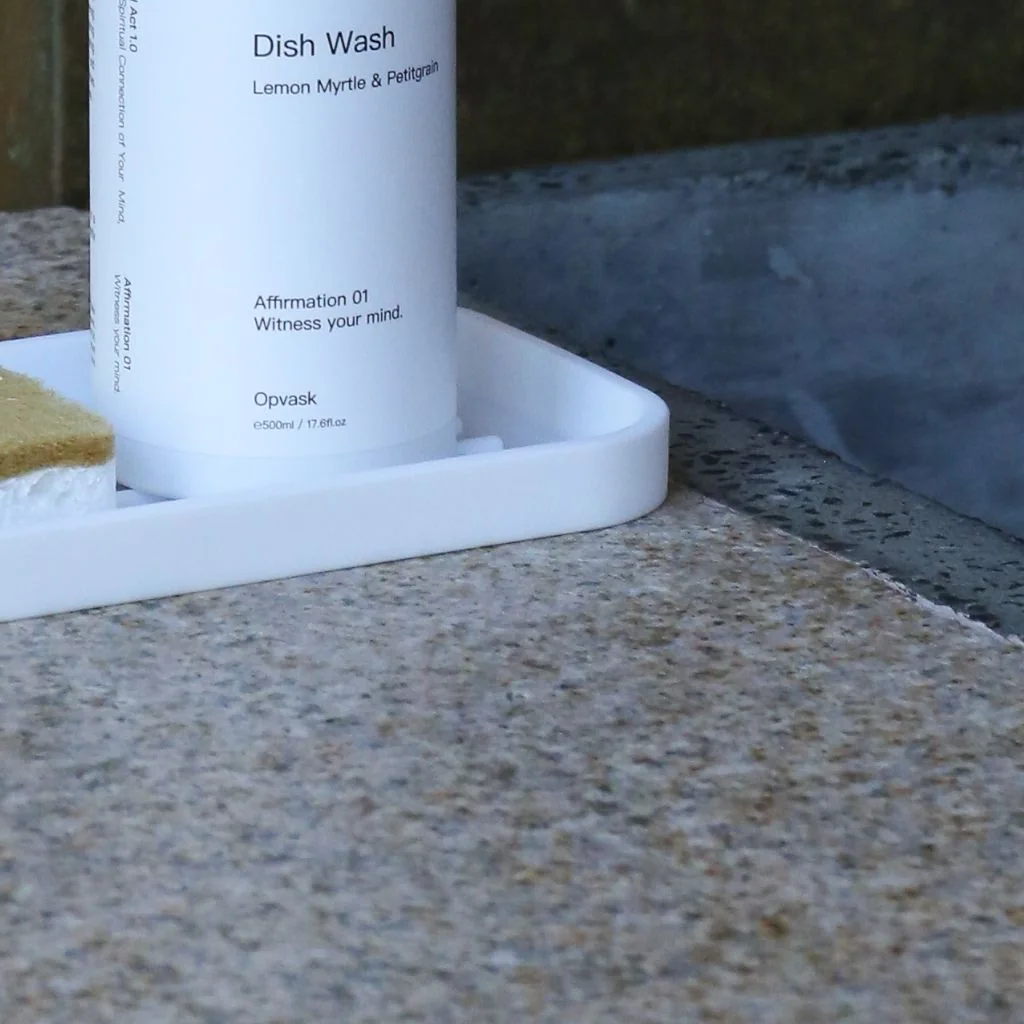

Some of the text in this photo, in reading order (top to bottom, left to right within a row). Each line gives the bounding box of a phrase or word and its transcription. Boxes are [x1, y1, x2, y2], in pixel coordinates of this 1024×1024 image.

[129, 6, 138, 30] Act
[129, 36, 138, 53] 1.0
[254, 26, 395, 57] Dish Wash
[118, 55, 127, 129] Connection
[253, 60, 439, 96] Lemon Myrtle & Petitgrain
[118, 132, 127, 147] of
[118, 152, 126, 182] Your
[117, 190, 126, 224] Mind,
[113, 274, 121, 325] Witness
[254, 289, 369, 310] Affirmation 01
[123, 277, 132, 370] Affirmation 01
[254, 305, 403, 333] Witness your mind.
[112, 329, 120, 358] your
[254, 391, 317, 409] Opvask
[297, 418, 304, 430] /
[307, 417, 346, 429] 17.6fl.oz
